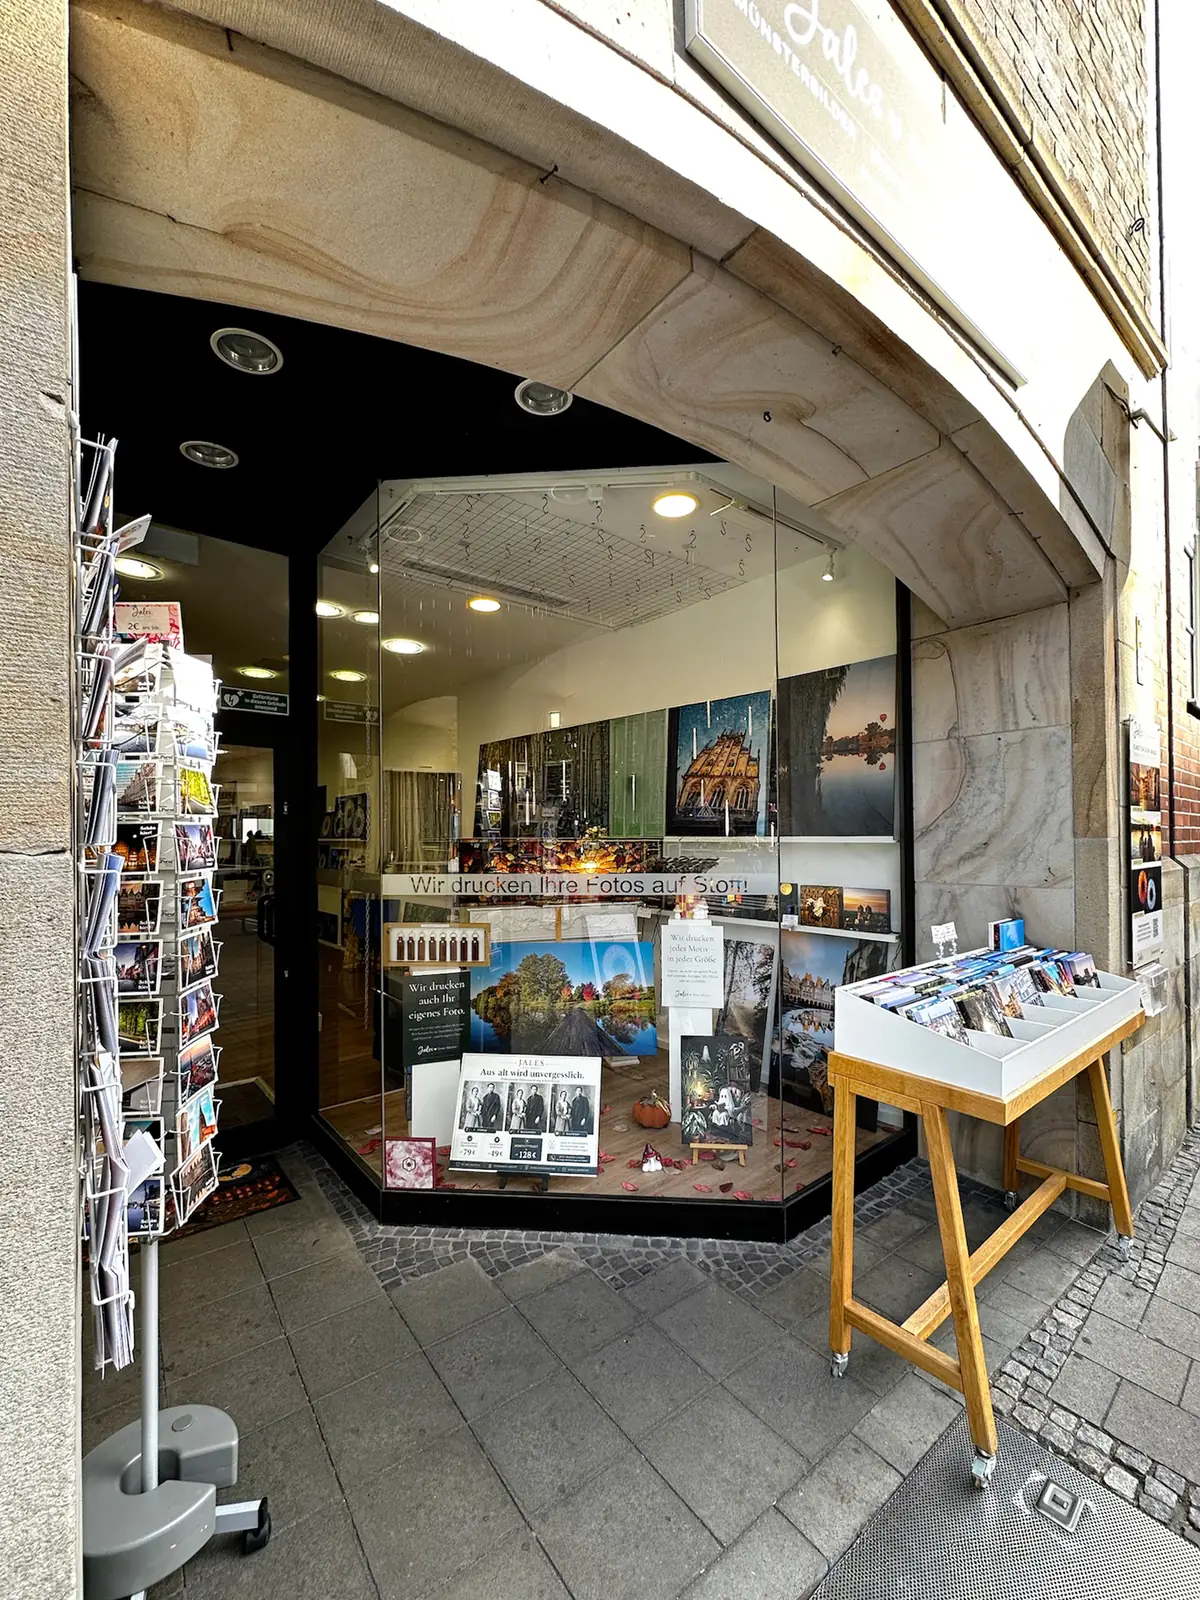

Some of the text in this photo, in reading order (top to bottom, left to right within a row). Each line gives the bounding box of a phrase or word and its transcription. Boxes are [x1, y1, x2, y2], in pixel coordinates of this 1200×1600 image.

[409, 876, 748, 893] Wir drucken Ihre Fotos auf Stoff!
[686, 934, 715, 942] drucken
[669, 944, 687, 953] jedes
[675, 955, 693, 964] jeder
[694, 955, 717, 963] Größe
[409, 980, 465, 992] Wir drucken
[419, 993, 456, 1005] auch Ihr
[408, 1007, 466, 1022] eigenes Foto.
[518, 1059, 545, 1067] JALES
[480, 1068, 496, 1076] Aus
[498, 1069, 509, 1077] alt
[510, 1069, 528, 1078] wird
[530, 1071, 585, 1080] unvergesslich.
